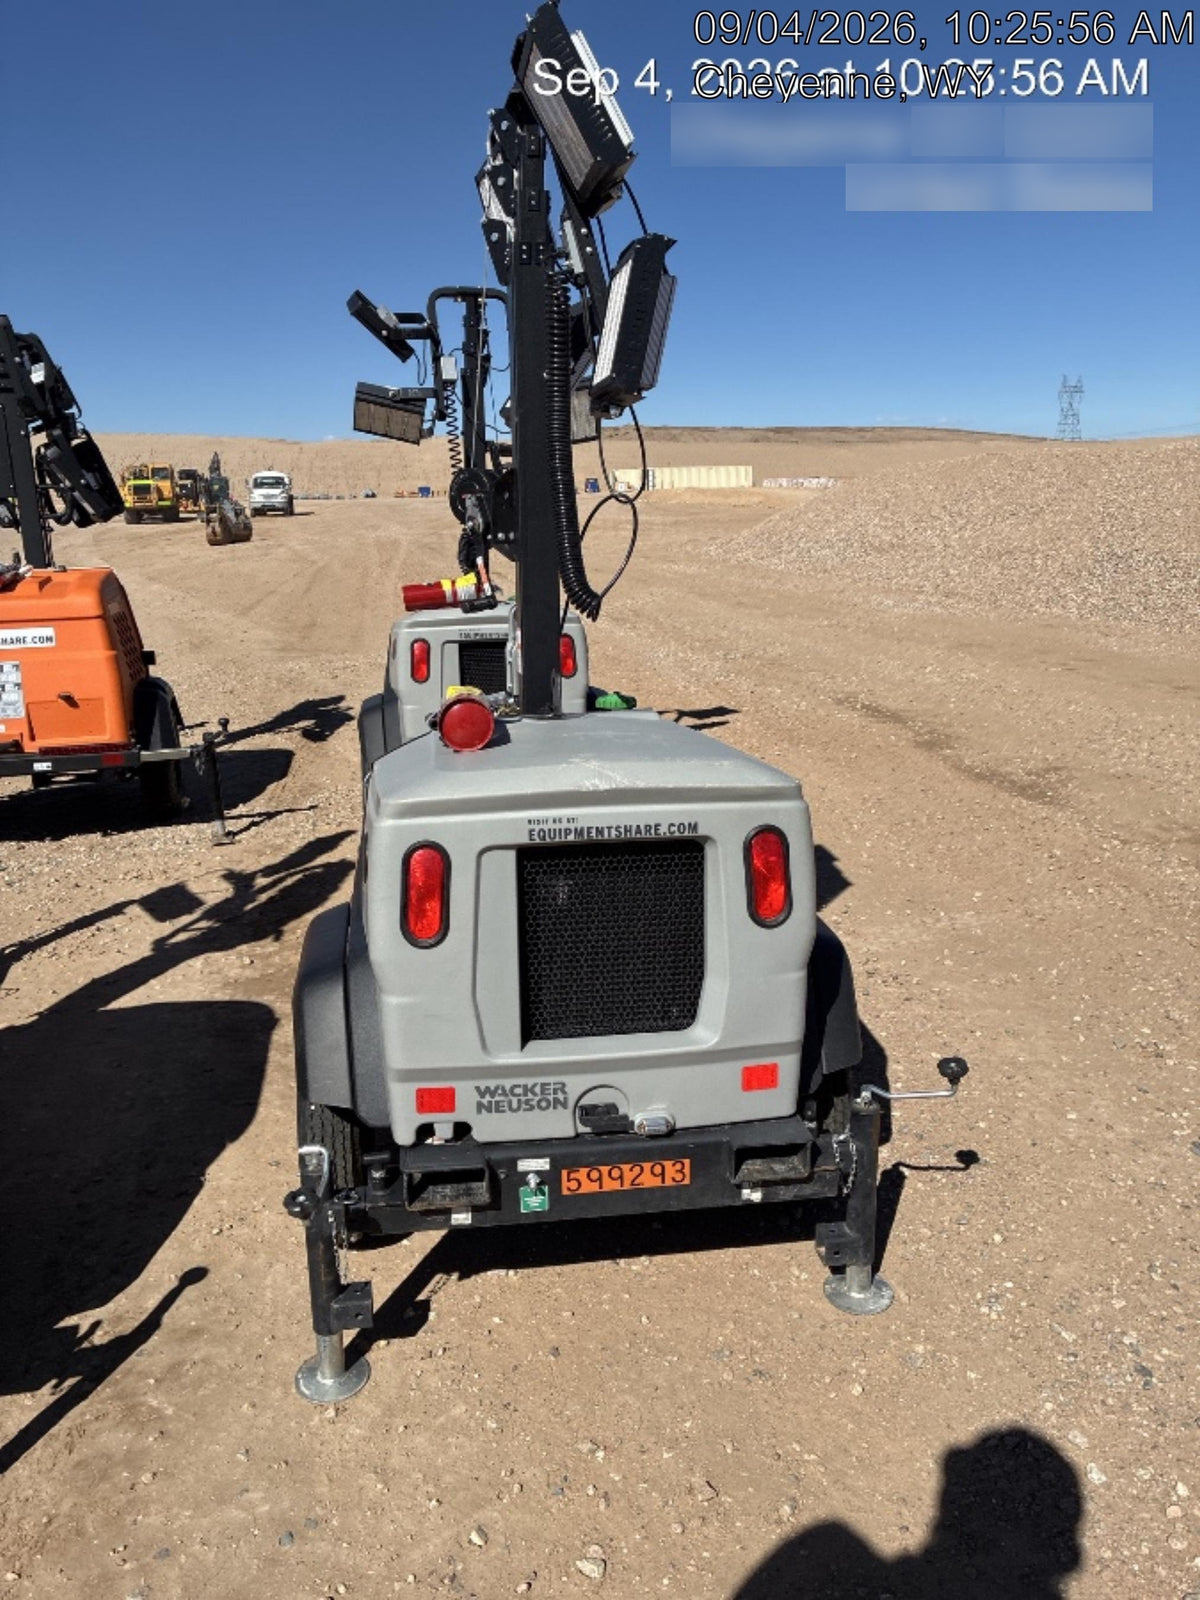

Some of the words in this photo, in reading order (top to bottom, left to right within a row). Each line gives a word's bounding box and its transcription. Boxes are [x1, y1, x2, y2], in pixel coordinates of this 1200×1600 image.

[528, 821, 699, 842] EQUIPMENTSHARE.COM
[474, 1082, 568, 1099] WACKER
[476, 1097, 569, 1115] NEUSON
[566, 1160, 687, 1193] 599293
